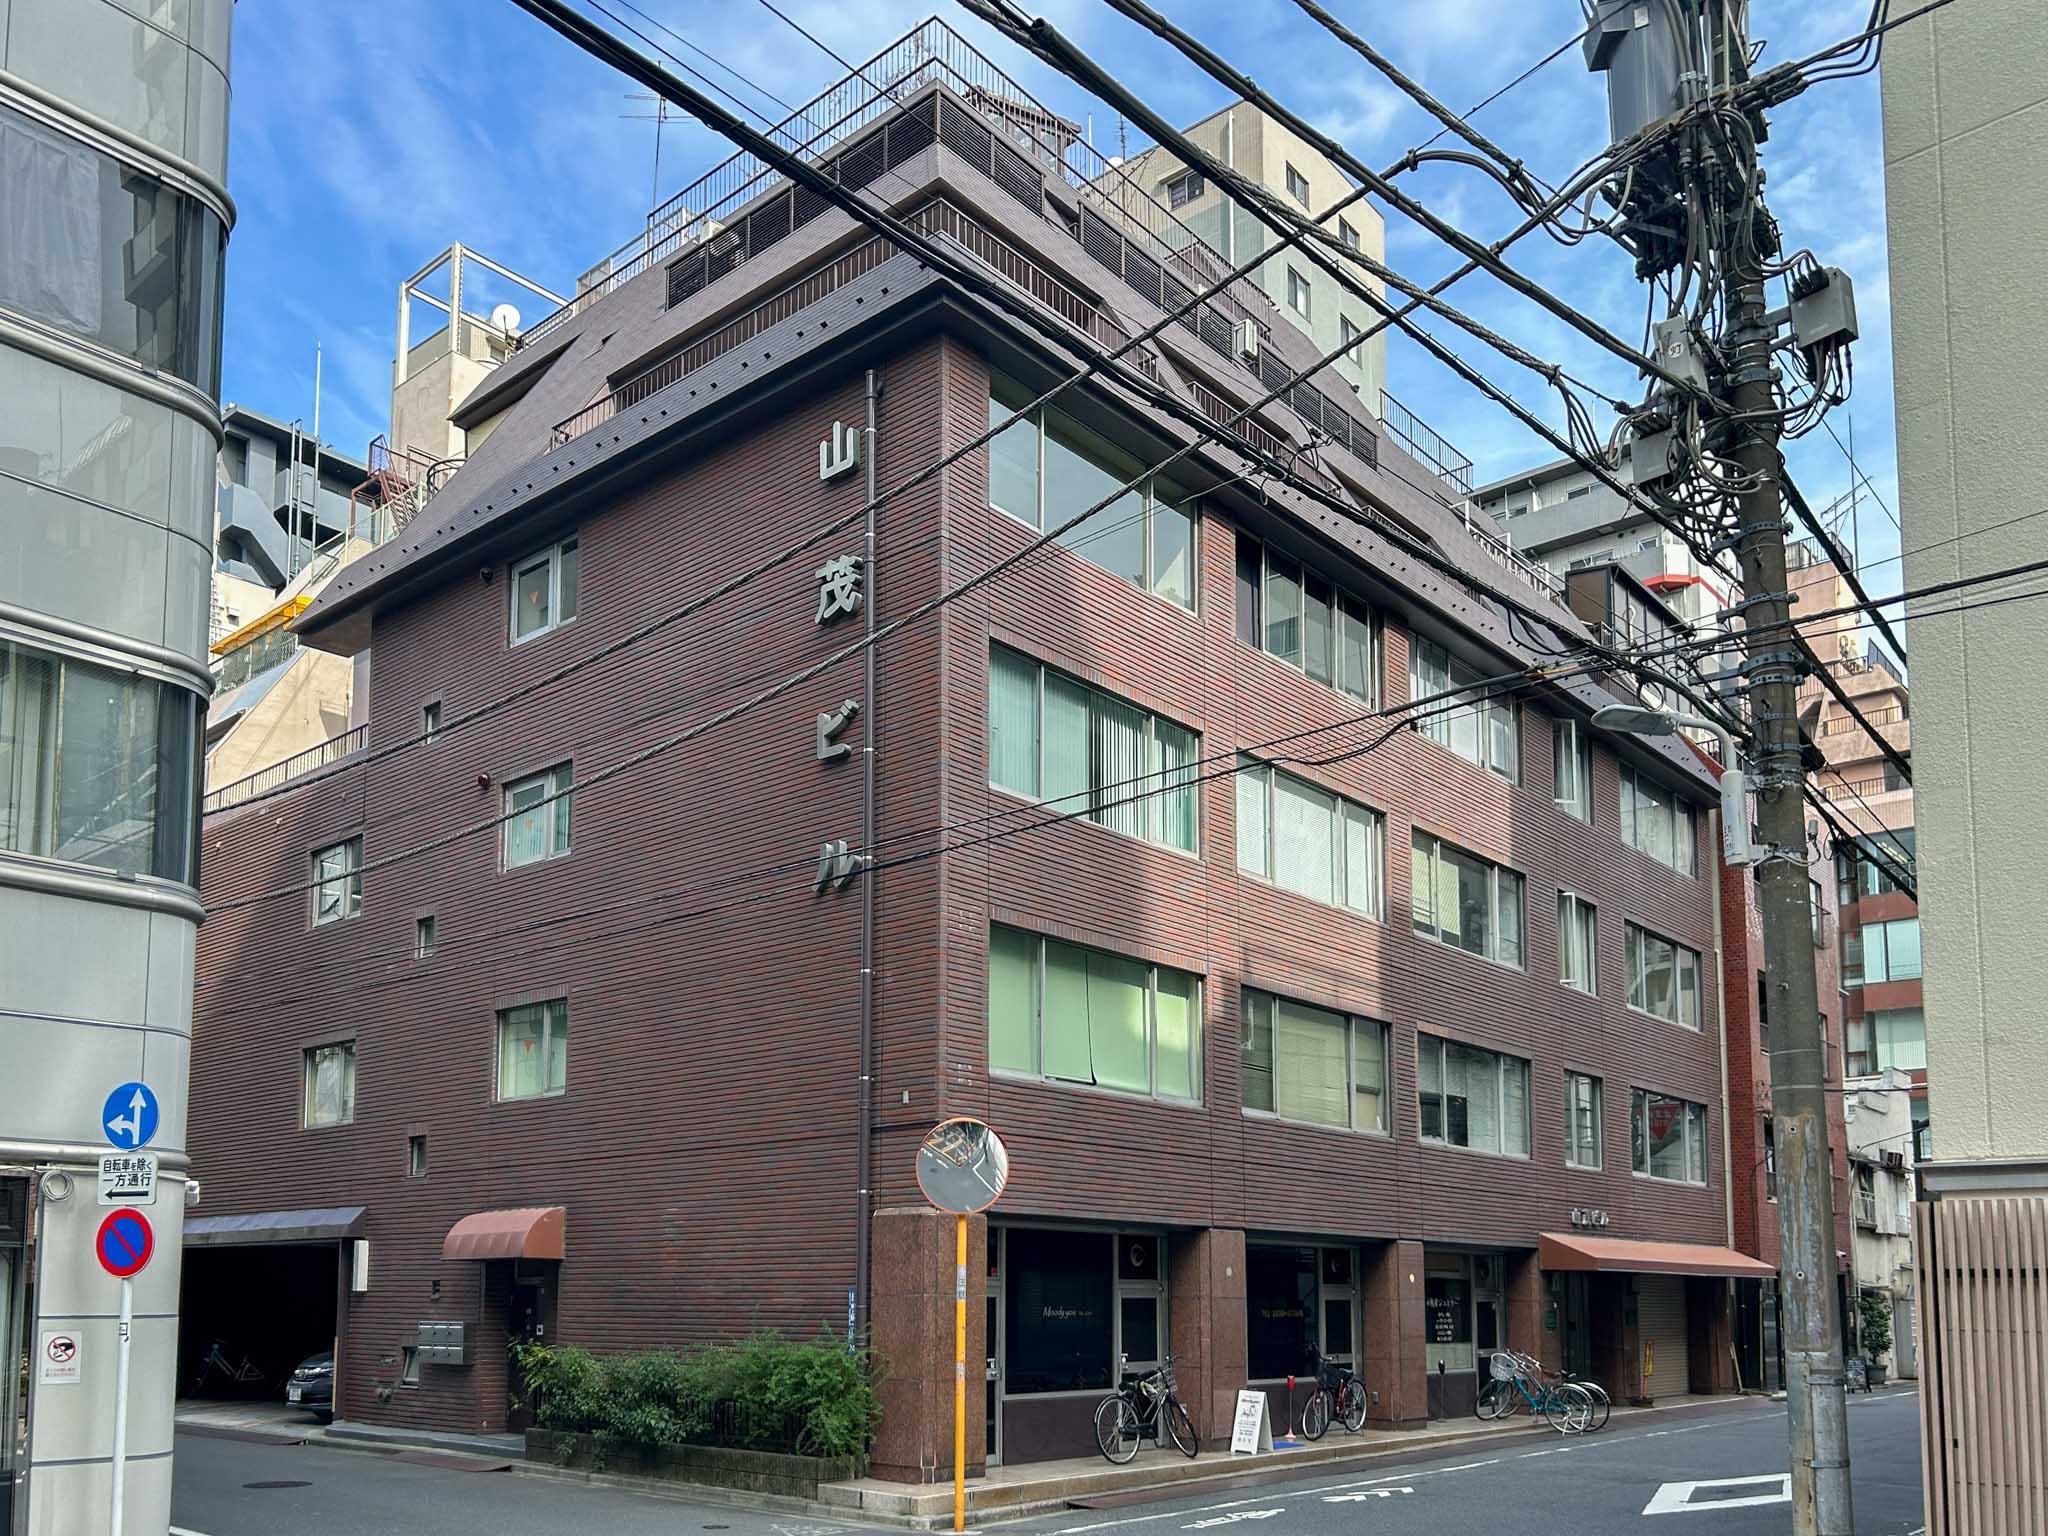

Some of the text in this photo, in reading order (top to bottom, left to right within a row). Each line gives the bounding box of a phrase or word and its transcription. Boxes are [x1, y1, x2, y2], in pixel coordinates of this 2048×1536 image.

[812, 420, 863, 894] 山茂ビル
[103, 1157, 152, 1172] 自転車を除く
[103, 1172, 152, 1187] 一方通行
